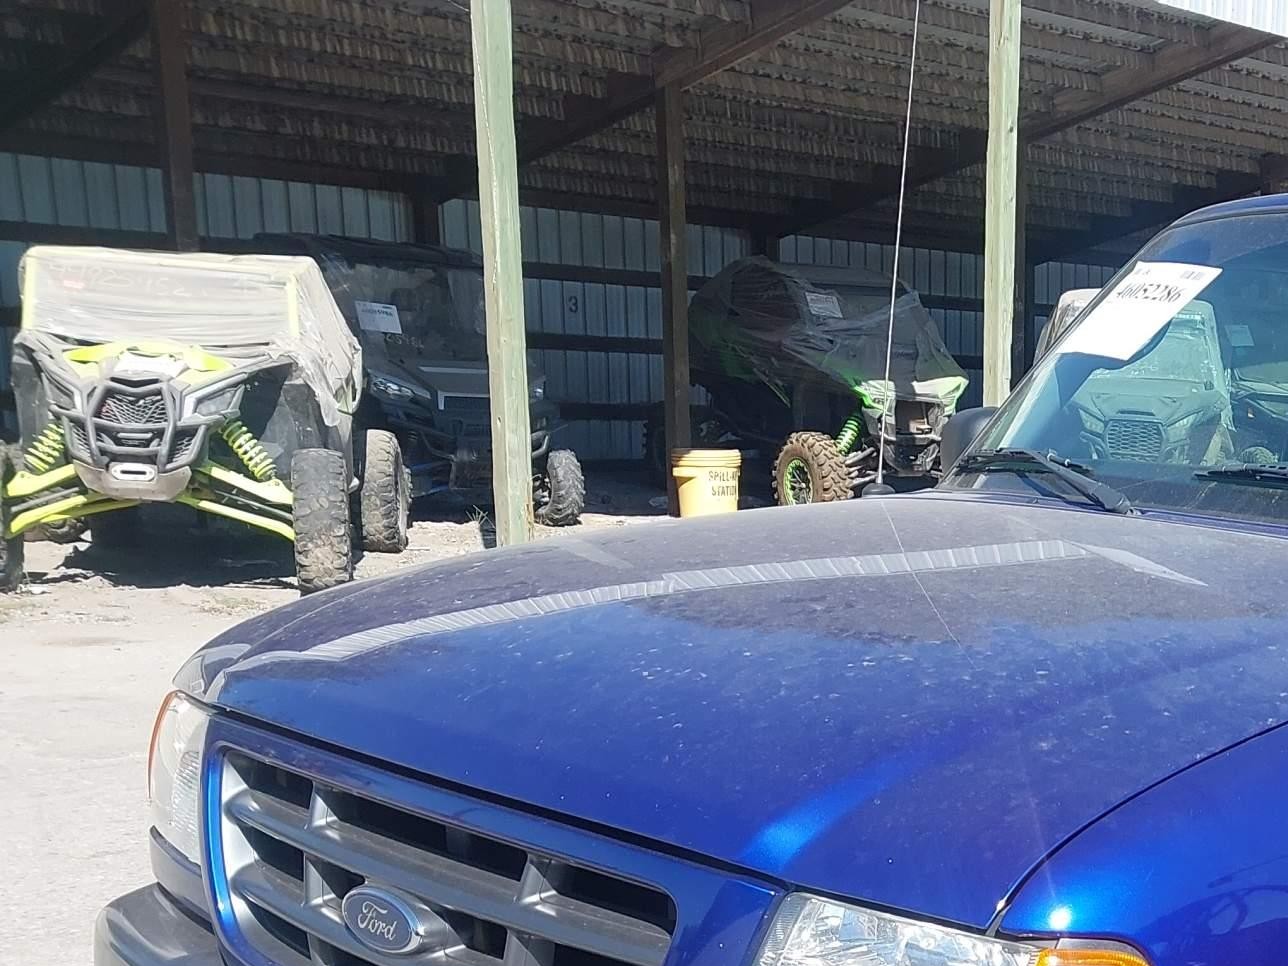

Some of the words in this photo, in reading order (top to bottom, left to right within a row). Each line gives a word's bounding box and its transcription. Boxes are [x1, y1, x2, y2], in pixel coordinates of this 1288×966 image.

[1116, 283, 1185, 303] 46052286
[568, 295, 579, 313] 3
[357, 900, 398, 941] Ford
